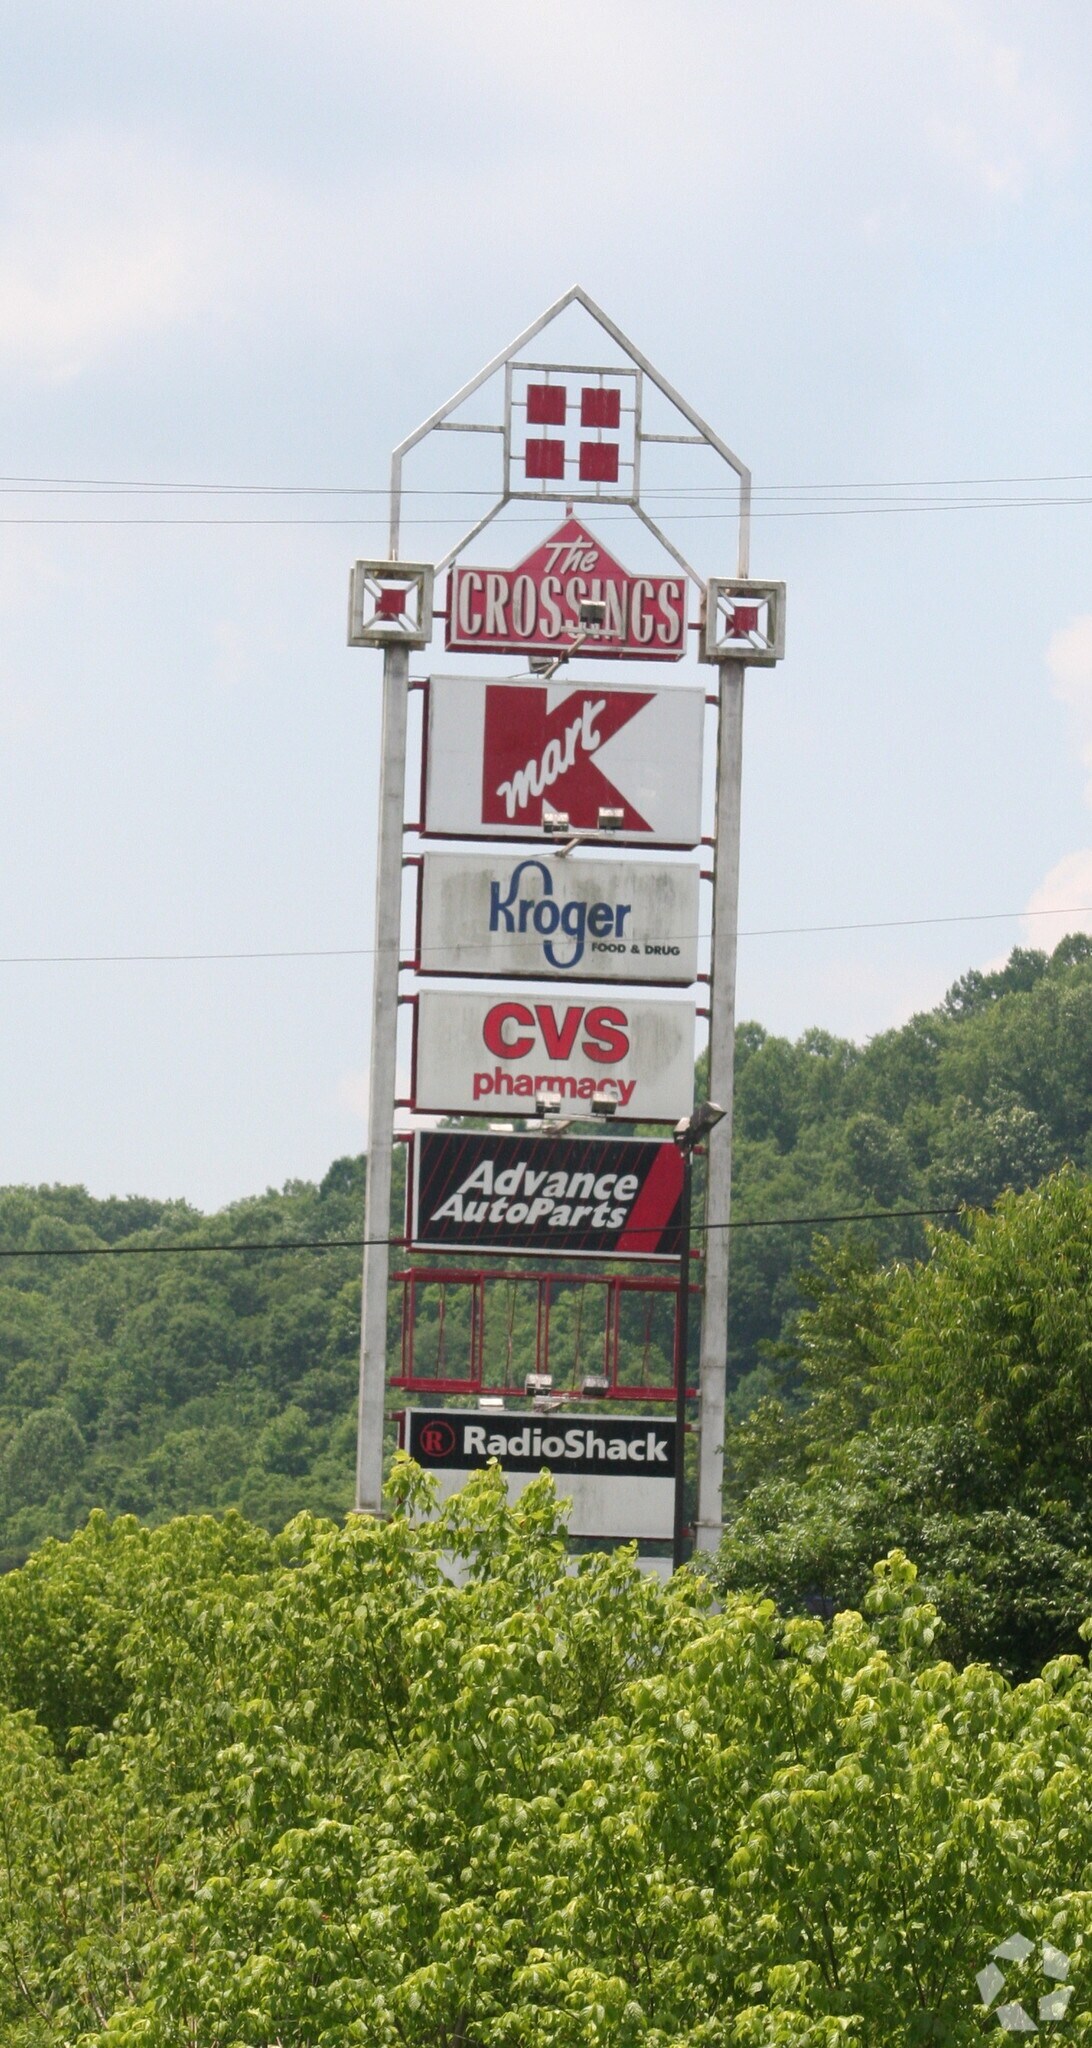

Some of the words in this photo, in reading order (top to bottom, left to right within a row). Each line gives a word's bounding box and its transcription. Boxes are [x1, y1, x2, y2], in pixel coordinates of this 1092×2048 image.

[545, 535, 599, 574] The
[459, 571, 681, 644] CROSSINGS
[489, 860, 631, 969] Kroger
[591, 942, 626, 954] FOOD
[631, 944, 640, 954] &
[645, 945, 681, 956] DRUG
[482, 1002, 630, 1064] CVS
[472, 1066, 637, 1107] pharmacy
[456, 1159, 639, 1201] Advance
[430, 1194, 628, 1229] AutoParts
[463, 1425, 669, 1462] RadioShack
